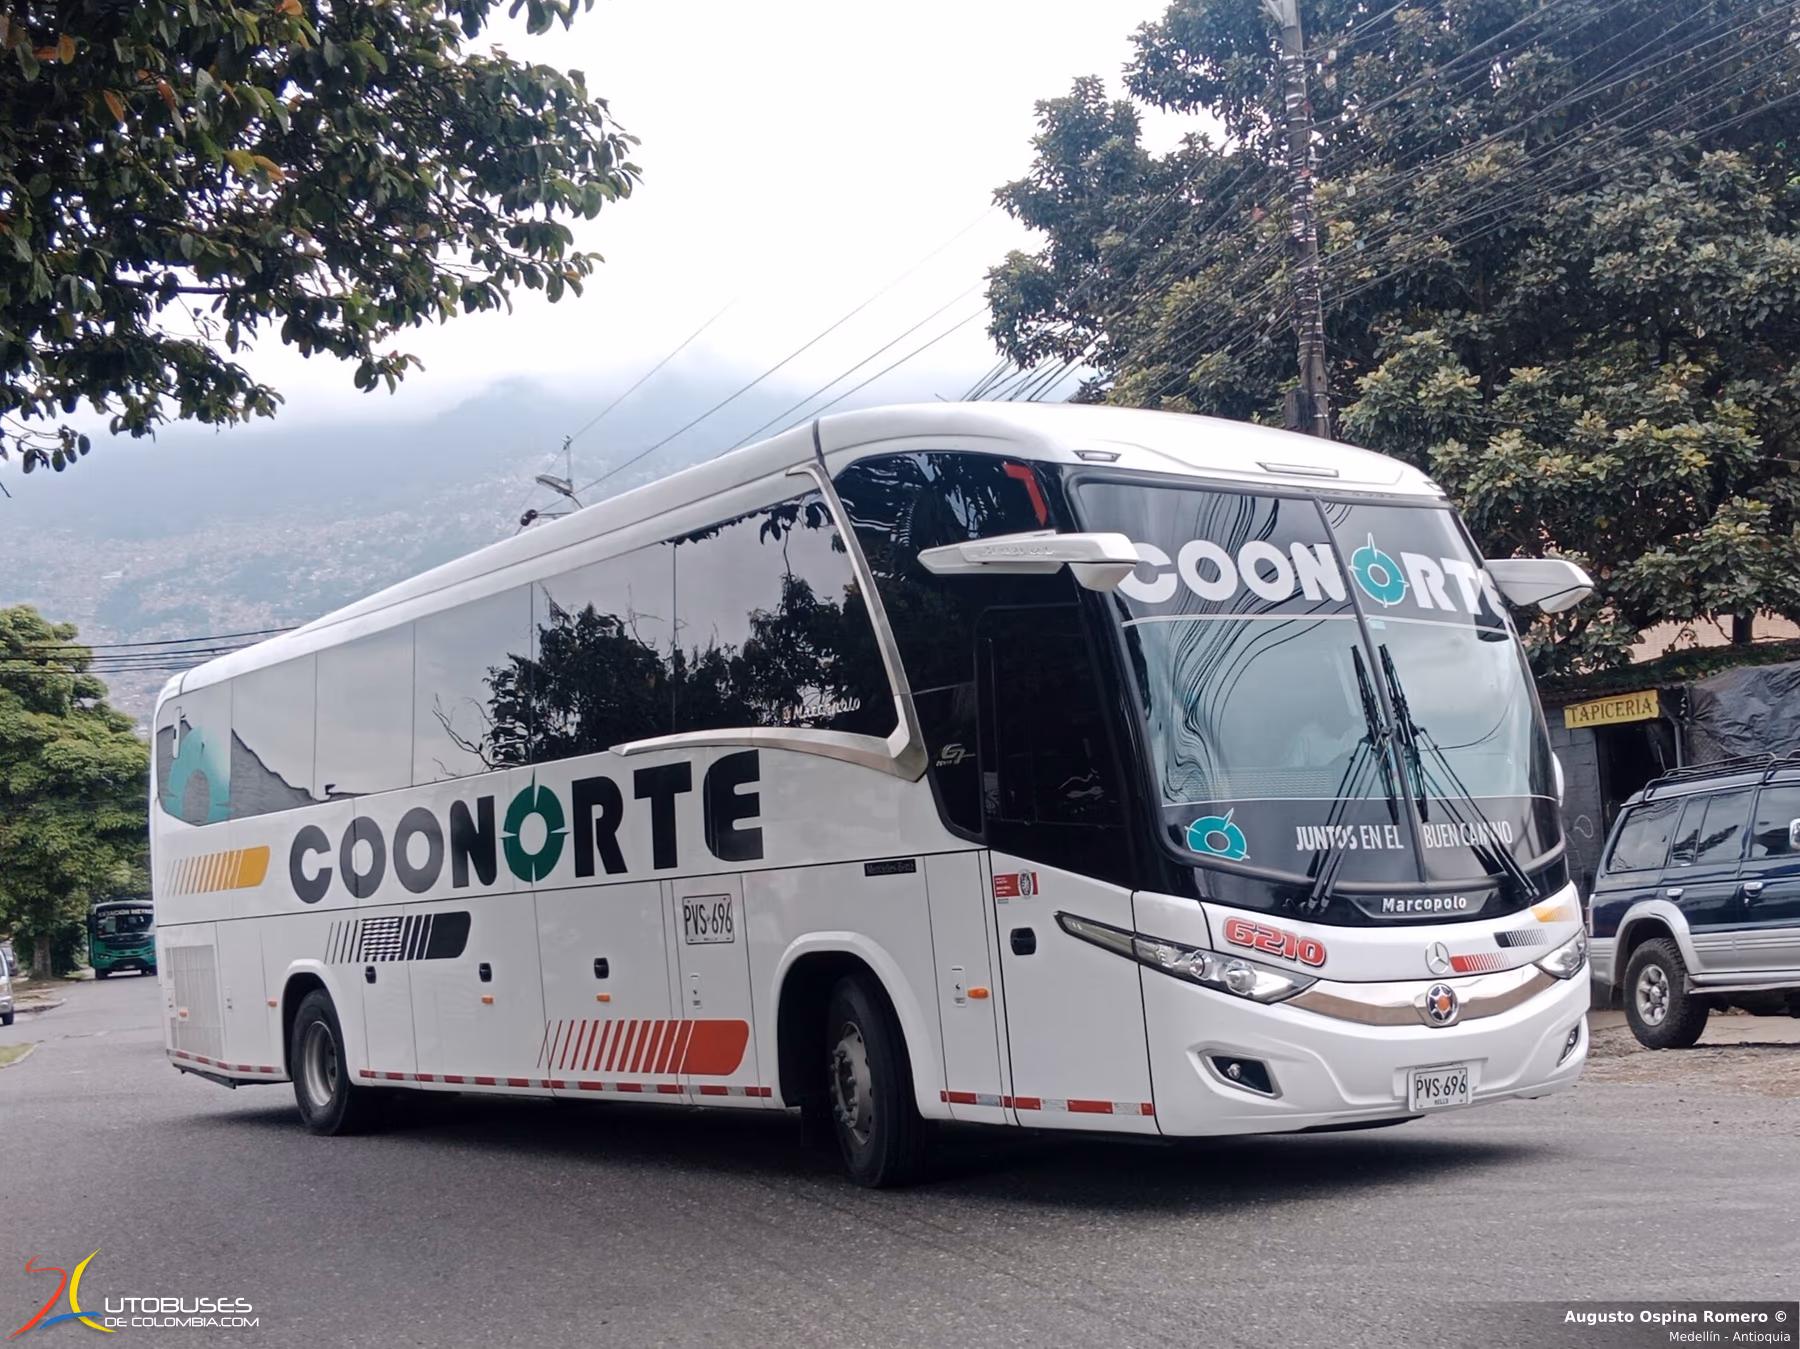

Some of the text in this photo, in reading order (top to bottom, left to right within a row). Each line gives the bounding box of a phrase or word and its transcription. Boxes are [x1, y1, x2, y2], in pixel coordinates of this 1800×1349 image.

[1569, 697, 1653, 723] TAPICERIA
[289, 749, 764, 904] COONORTE
[1296, 824, 1358, 851] JUNTOS
[1360, 824, 1382, 850] EN
[1386, 823, 1404, 849] EL
[1422, 821, 1460, 849] BUEN
[684, 901, 733, 936] PVS 696
[1381, 895, 1467, 913] Marcopolo
[1224, 916, 1327, 968] 6210
[1416, 1073, 1467, 1100] PVS 696
